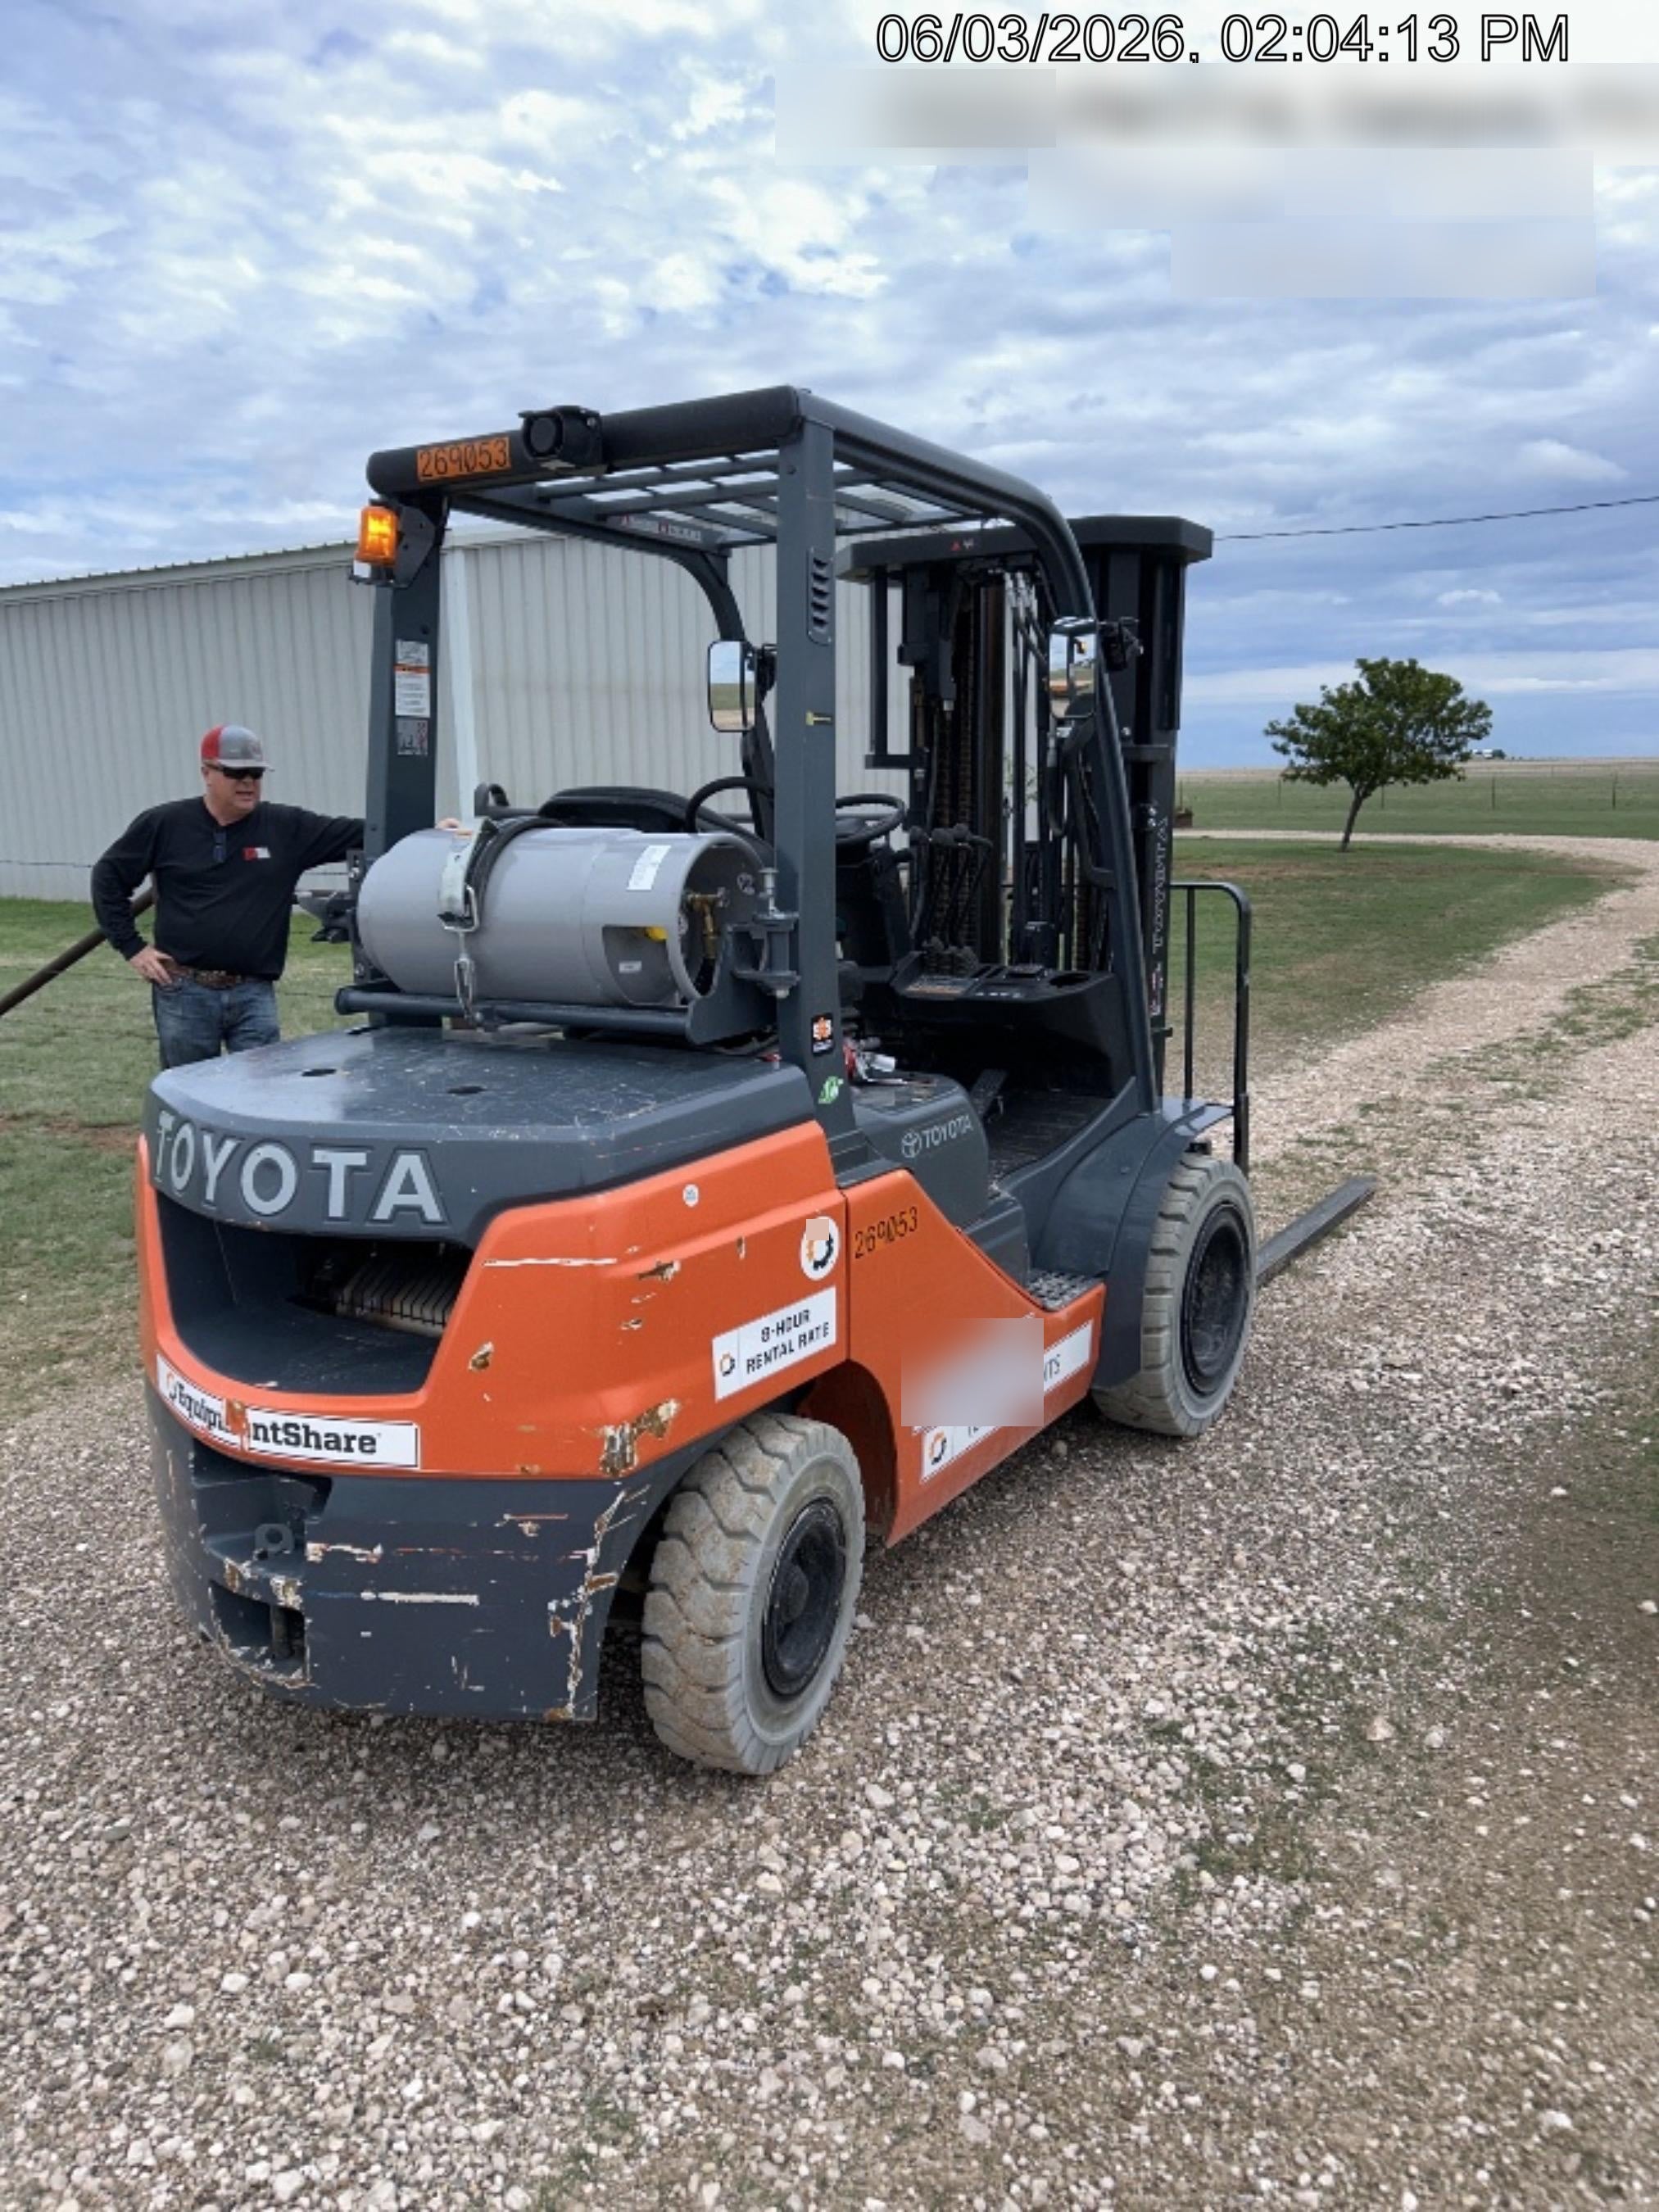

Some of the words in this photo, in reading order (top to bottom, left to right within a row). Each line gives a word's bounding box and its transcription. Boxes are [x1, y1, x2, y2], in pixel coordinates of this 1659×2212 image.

[419, 438, 507, 477] 269053
[922, 1115, 972, 1149] TOYOTA
[156, 1109, 443, 1221] TOYOTA
[854, 1206, 918, 1258] 269053
[746, 1339, 795, 1375] RENTAL
[799, 1321, 829, 1349] RATE
[761, 1309, 809, 1342] 8-HOUR
